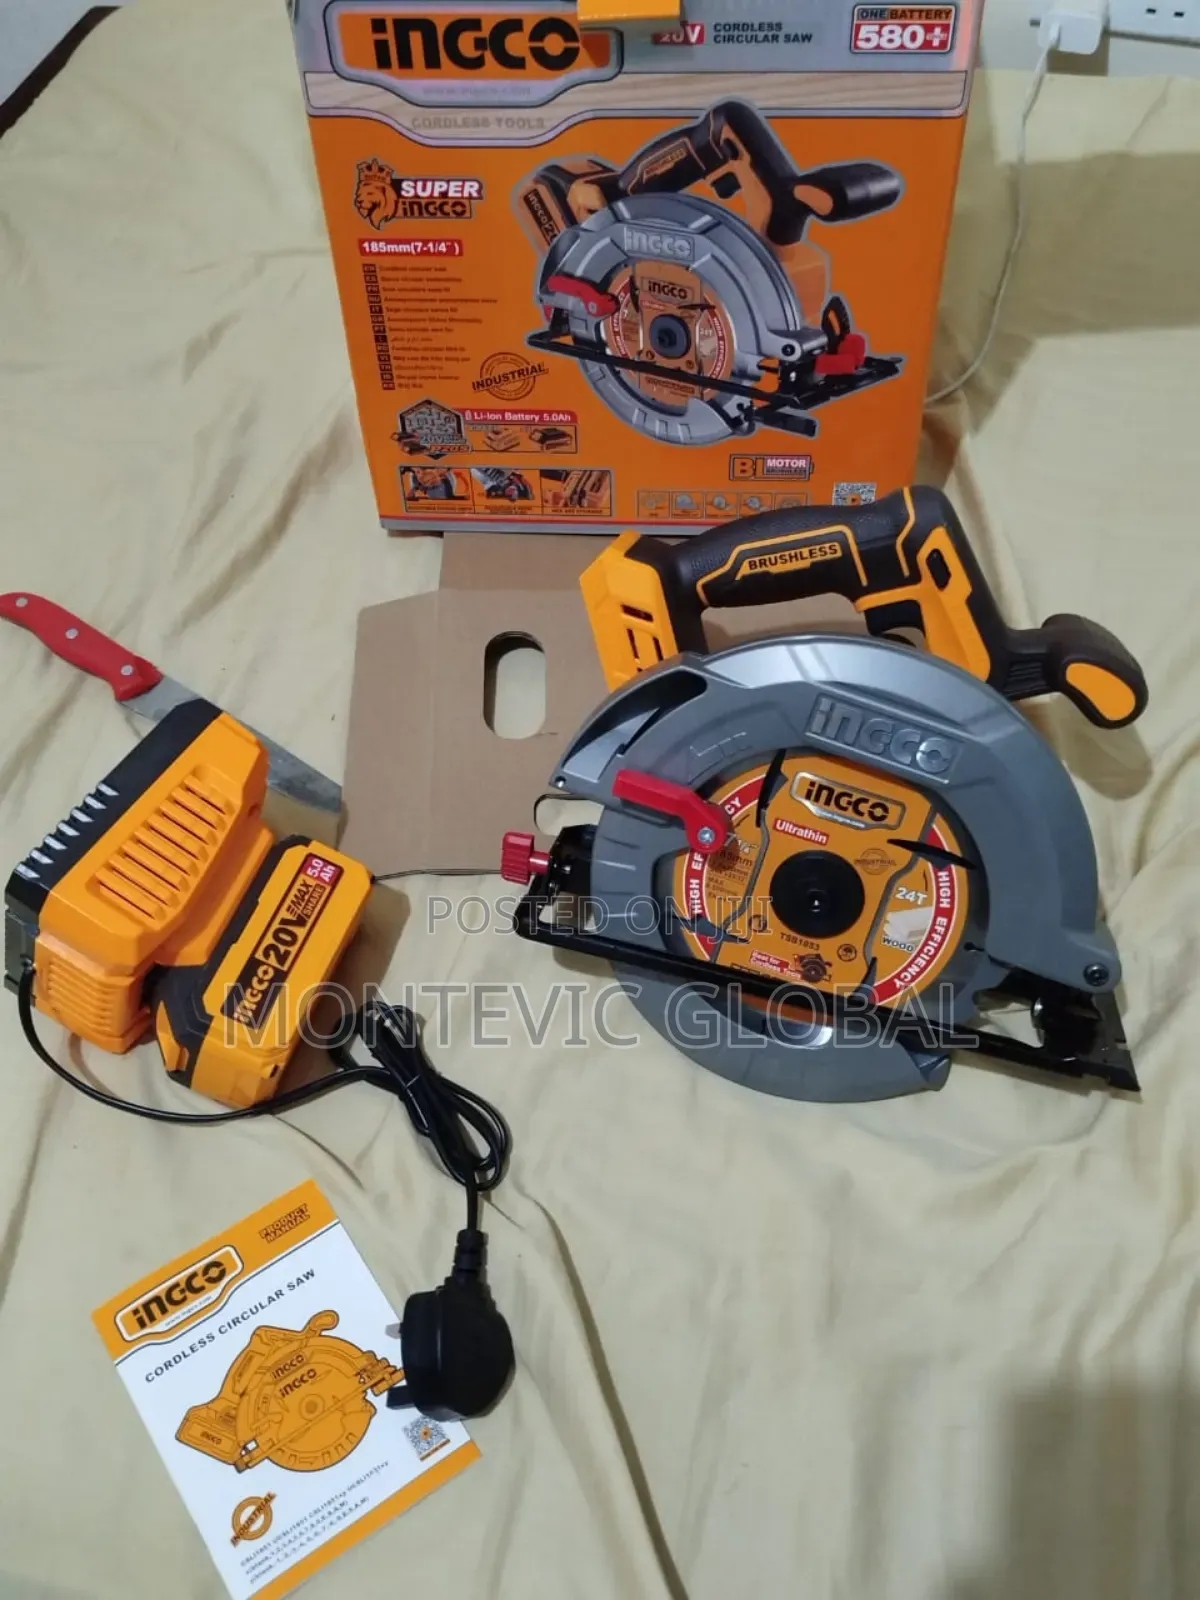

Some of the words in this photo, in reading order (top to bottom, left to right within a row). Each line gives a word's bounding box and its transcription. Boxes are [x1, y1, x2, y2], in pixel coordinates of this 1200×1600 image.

[713, 22, 783, 32] CORDLESS
[860, 9, 888, 20] ONE
[889, 9, 953, 20] BATTERY
[713, 34, 780, 44] CIRCULAR
[783, 33, 813, 44] SAW
[856, 24, 948, 49] 580+
[411, 116, 491, 130] CORDLESS
[494, 117, 545, 130] TOOLS
[401, 180, 480, 198] SUPER
[471, 362, 546, 391] INDUSTRIAL
[504, 411, 540, 423] Battery
[543, 412, 571, 422] 5.0Ah
[767, 458, 806, 468] MOTOR
[748, 544, 838, 571] BRUSHLESS
[775, 819, 828, 845] Ultrathin
[307, 859, 324, 878] 5.0
[319, 864, 336, 883] Ah
[303, 883, 327, 918] SHARE
[689, 878, 703, 915] HIGH
[895, 887, 928, 905] 24T
[937, 870, 951, 909] HIGH
[262, 913, 309, 968] 20V
[882, 936, 915, 953] WOOD
[893, 916, 948, 989] EFFICIENCY
[258, 1203, 309, 1240] PRODUCT
[265, 1213, 311, 1245] MANUAL
[144, 1330, 216, 1384] CORDLESS
[217, 1288, 286, 1336] CIRCULAR
[286, 1268, 316, 1292] SAW
[230, 1490, 278, 1548] INDUSTRIAL
